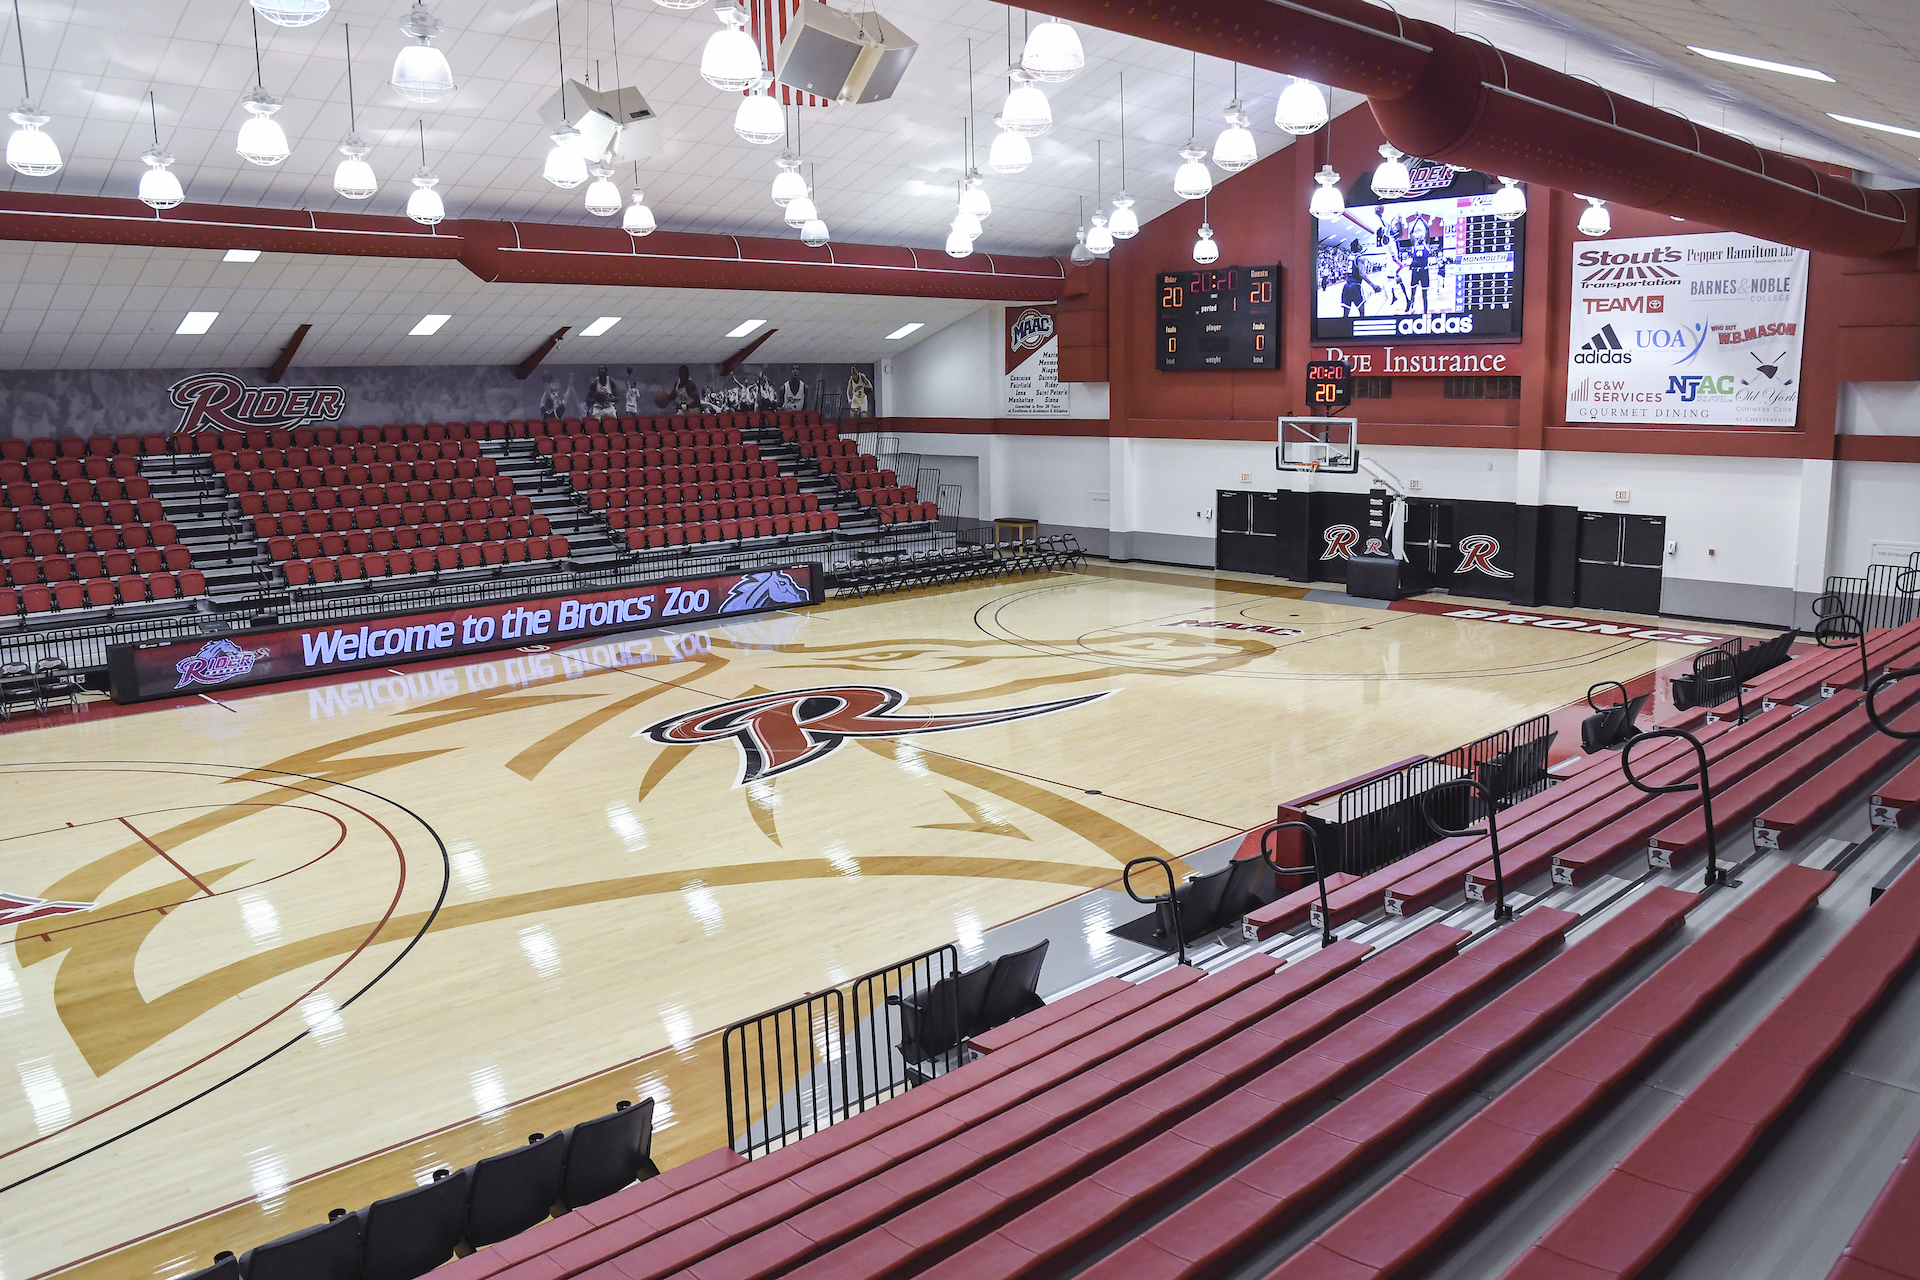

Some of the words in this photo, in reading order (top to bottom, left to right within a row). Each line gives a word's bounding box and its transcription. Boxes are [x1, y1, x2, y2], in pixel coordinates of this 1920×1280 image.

[1462, 255, 1507, 263] MONMOUTH
[1578, 246, 1682, 266] Stout's
[1687, 249, 1723, 262] Pepper
[1726, 246, 1778, 259] Hamilton
[1191, 270, 1238, 293] 20:20
[1250, 269, 1269, 278] Guests
[1580, 278, 1681, 289] Transportation
[1163, 286, 1183, 308] 20
[1250, 281, 1272, 303] 20
[1750, 294, 1790, 302] COLLEGE
[1200, 304, 1217, 314] period
[1583, 296, 1643, 314] TEAM
[1013, 317, 1051, 347] MAAC
[1165, 325, 1177, 334] fouls
[1205, 324, 1222, 333] player
[1252, 322, 1265, 331] fouls
[1399, 313, 1473, 335] adidas
[1168, 337, 1177, 353] 0
[1255, 334, 1265, 351] 0
[1635, 329, 1687, 348] UOA
[1205, 356, 1222, 364] weight
[1383, 346, 1506, 372] Insurance
[1574, 350, 1632, 364] adidas
[1038, 374, 1058, 382] Quinnip
[1309, 366, 1343, 380] 20:20
[1315, 383, 1336, 402] 20
[1594, 381, 1625, 391] C&W
[1666, 375, 1734, 402] NJAC
[168, 372, 347, 434] RIDER
[1594, 392, 1662, 402] SERVICES
[1735, 388, 1760, 402] Old
[1761, 387, 1797, 406] York
[1580, 408, 1648, 417] GOURMET
[1655, 409, 1709, 418] DINING
[1616, 490, 1627, 499] EXIT
[1454, 534, 1514, 578] R
[302, 619, 455, 666] Welcome
[462, 614, 495, 645] to
[501, 607, 551, 640] the
[558, 594, 655, 632] Broncs'
[662, 586, 710, 617] Zoo
[1442, 608, 1724, 645] BRONCS
[174, 653, 257, 690] RIDER
